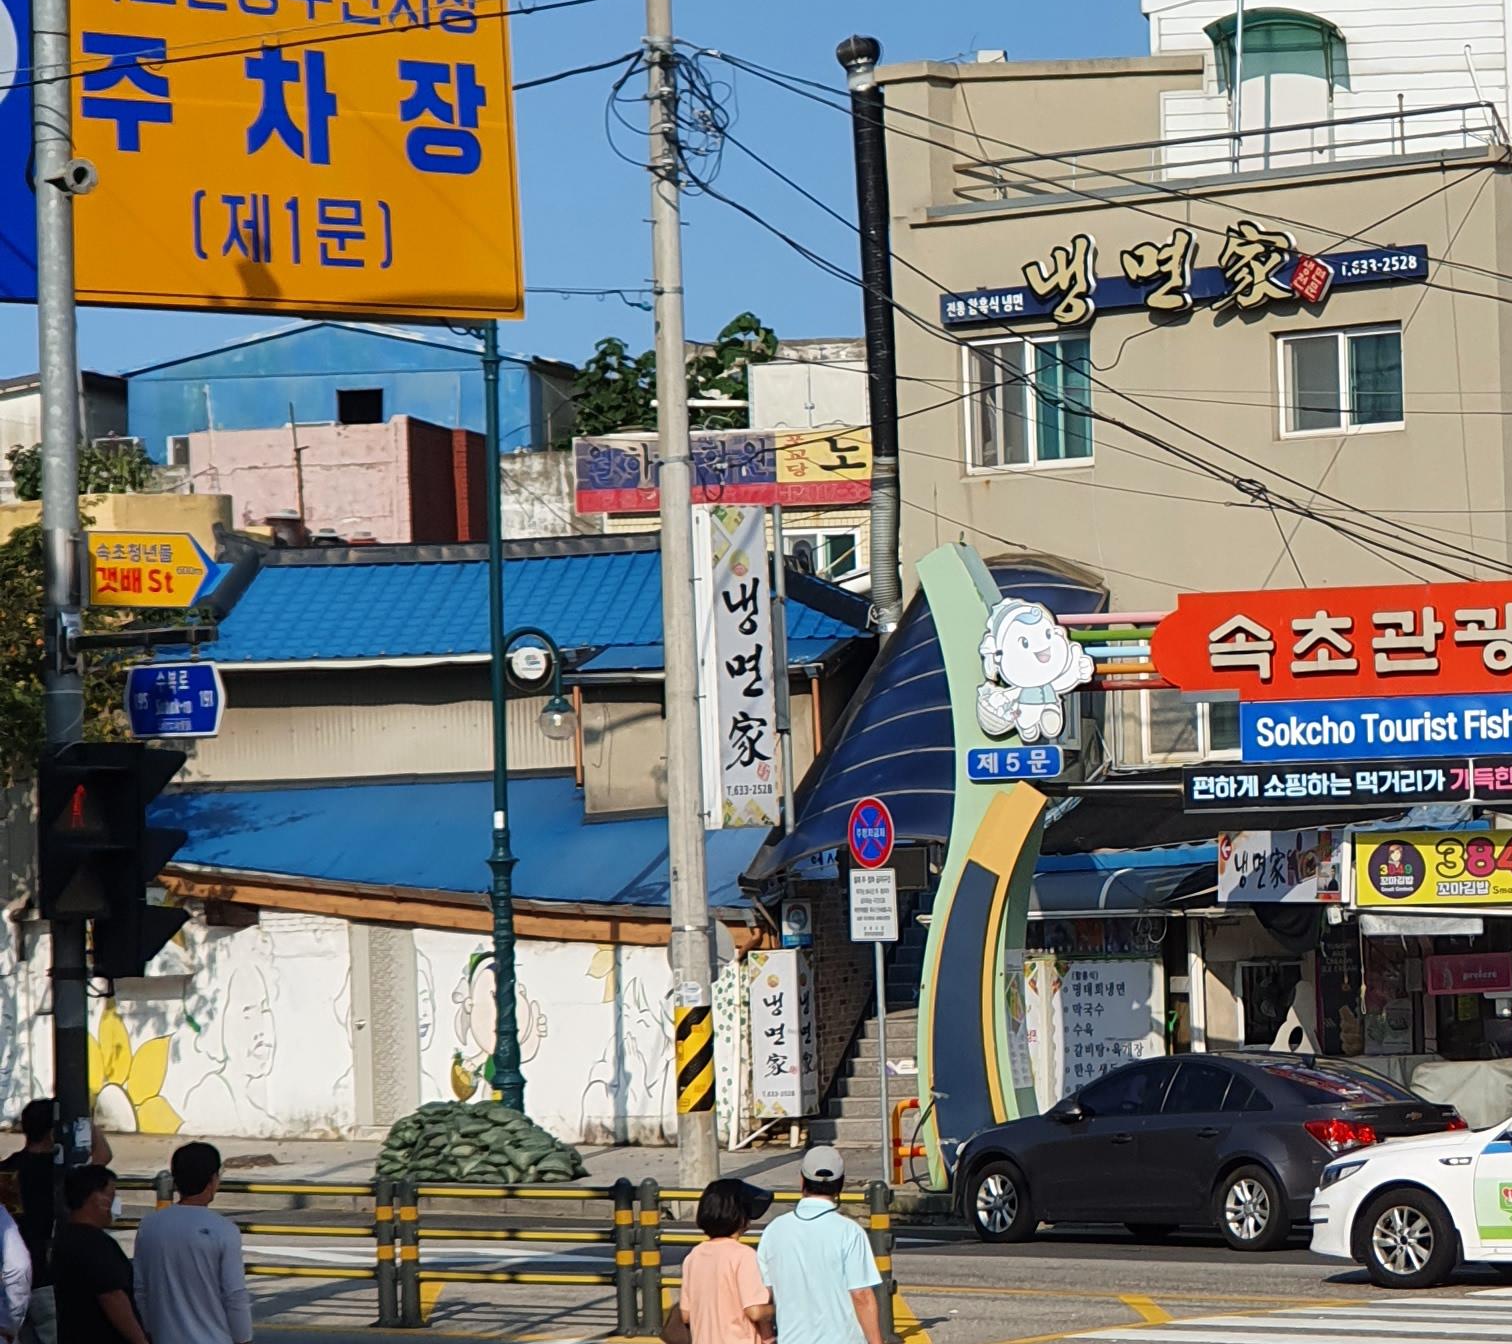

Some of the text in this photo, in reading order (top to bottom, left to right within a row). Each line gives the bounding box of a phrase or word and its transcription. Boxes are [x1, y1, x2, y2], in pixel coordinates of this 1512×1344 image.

[193, 189, 393, 270] (제1문)
[946, 301, 966, 317] 전통
[1001, 292, 1024, 312] 냉면
[96, 567, 142, 593] 갯배
[1256, 714, 1356, 747] Sokcho
[1361, 711, 1458, 743] Tourist
[1191, 773, 1259, 799] 편하게
[1263, 771, 1352, 798] 쇼핑하는
[1355, 767, 1446, 794] 먹거리가
[1436, 880, 1491, 896] 꼬마김밥
[1072, 1003, 1105, 1017] 막국수
[1073, 1023, 1094, 1036] 수육
